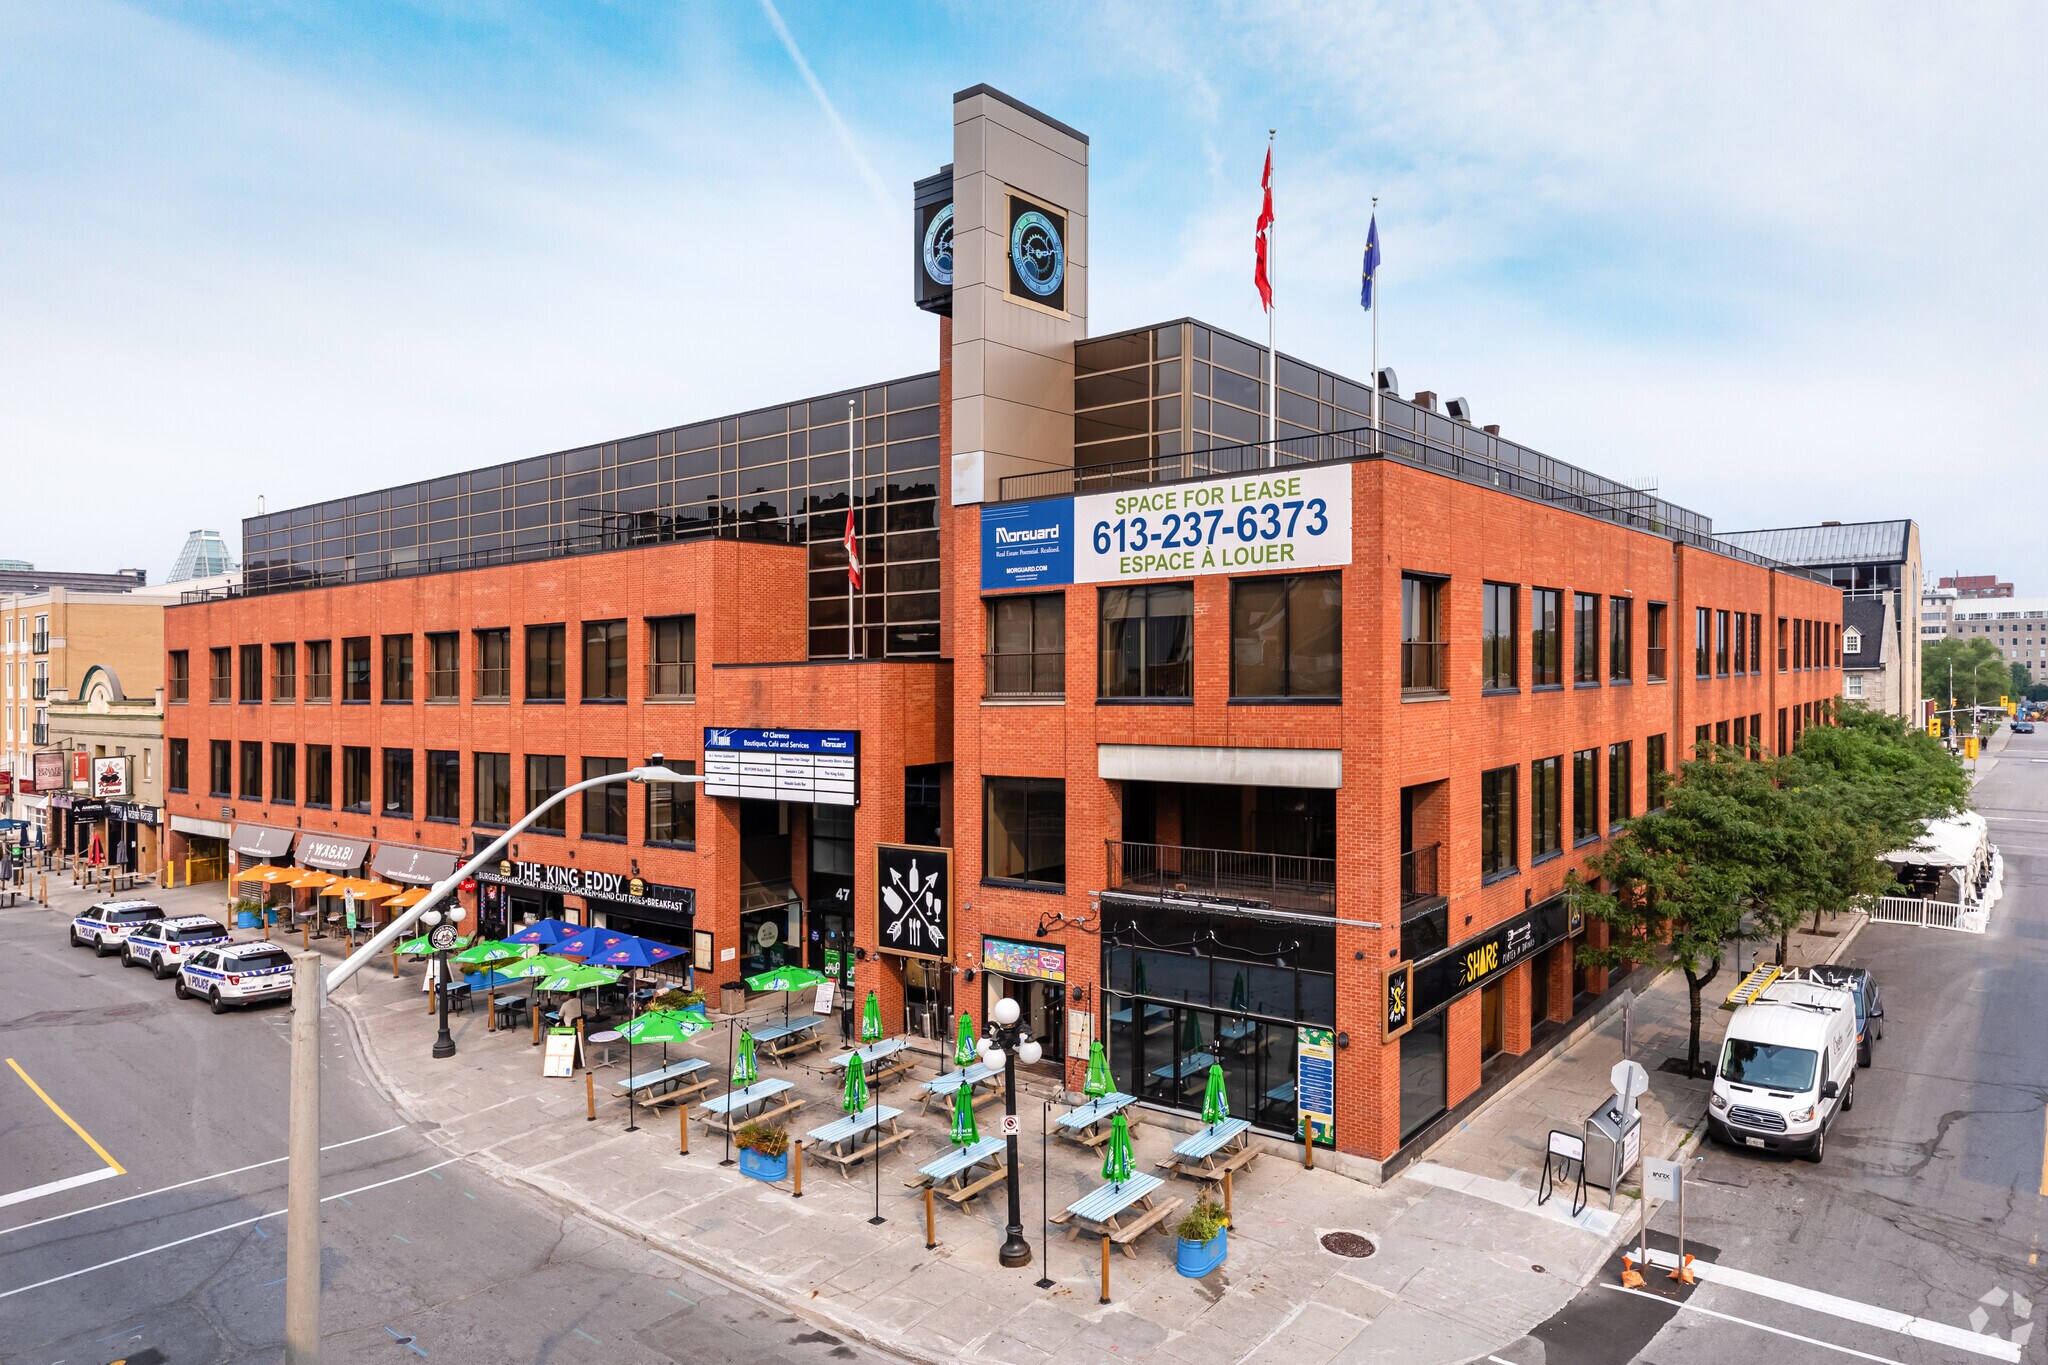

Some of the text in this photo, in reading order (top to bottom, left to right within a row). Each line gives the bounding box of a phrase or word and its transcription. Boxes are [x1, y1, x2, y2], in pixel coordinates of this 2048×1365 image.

[1115, 477, 1301, 516] SPACE FOR LEASE
[995, 524, 1060, 544] Morguard
[1092, 498, 1329, 556] 613-237-6373
[1120, 543, 1295, 574] ESPACE À LOUER
[1006, 564, 1048, 574] MORGUARD.COM
[762, 731, 790, 740] 47 Clarence
[743, 739, 768, 748] Boutiques,
[789, 741, 810, 749] Services
[516, 861, 623, 894] THE KING EDDY
[615, 893, 628, 902] CUT
[835, 887, 850, 901] 47
[81, 927, 95, 939] POLICE
[136, 945, 151, 958] POLICE
[1467, 941, 1499, 983] SHARE
[192, 975, 209, 990] POLICE
